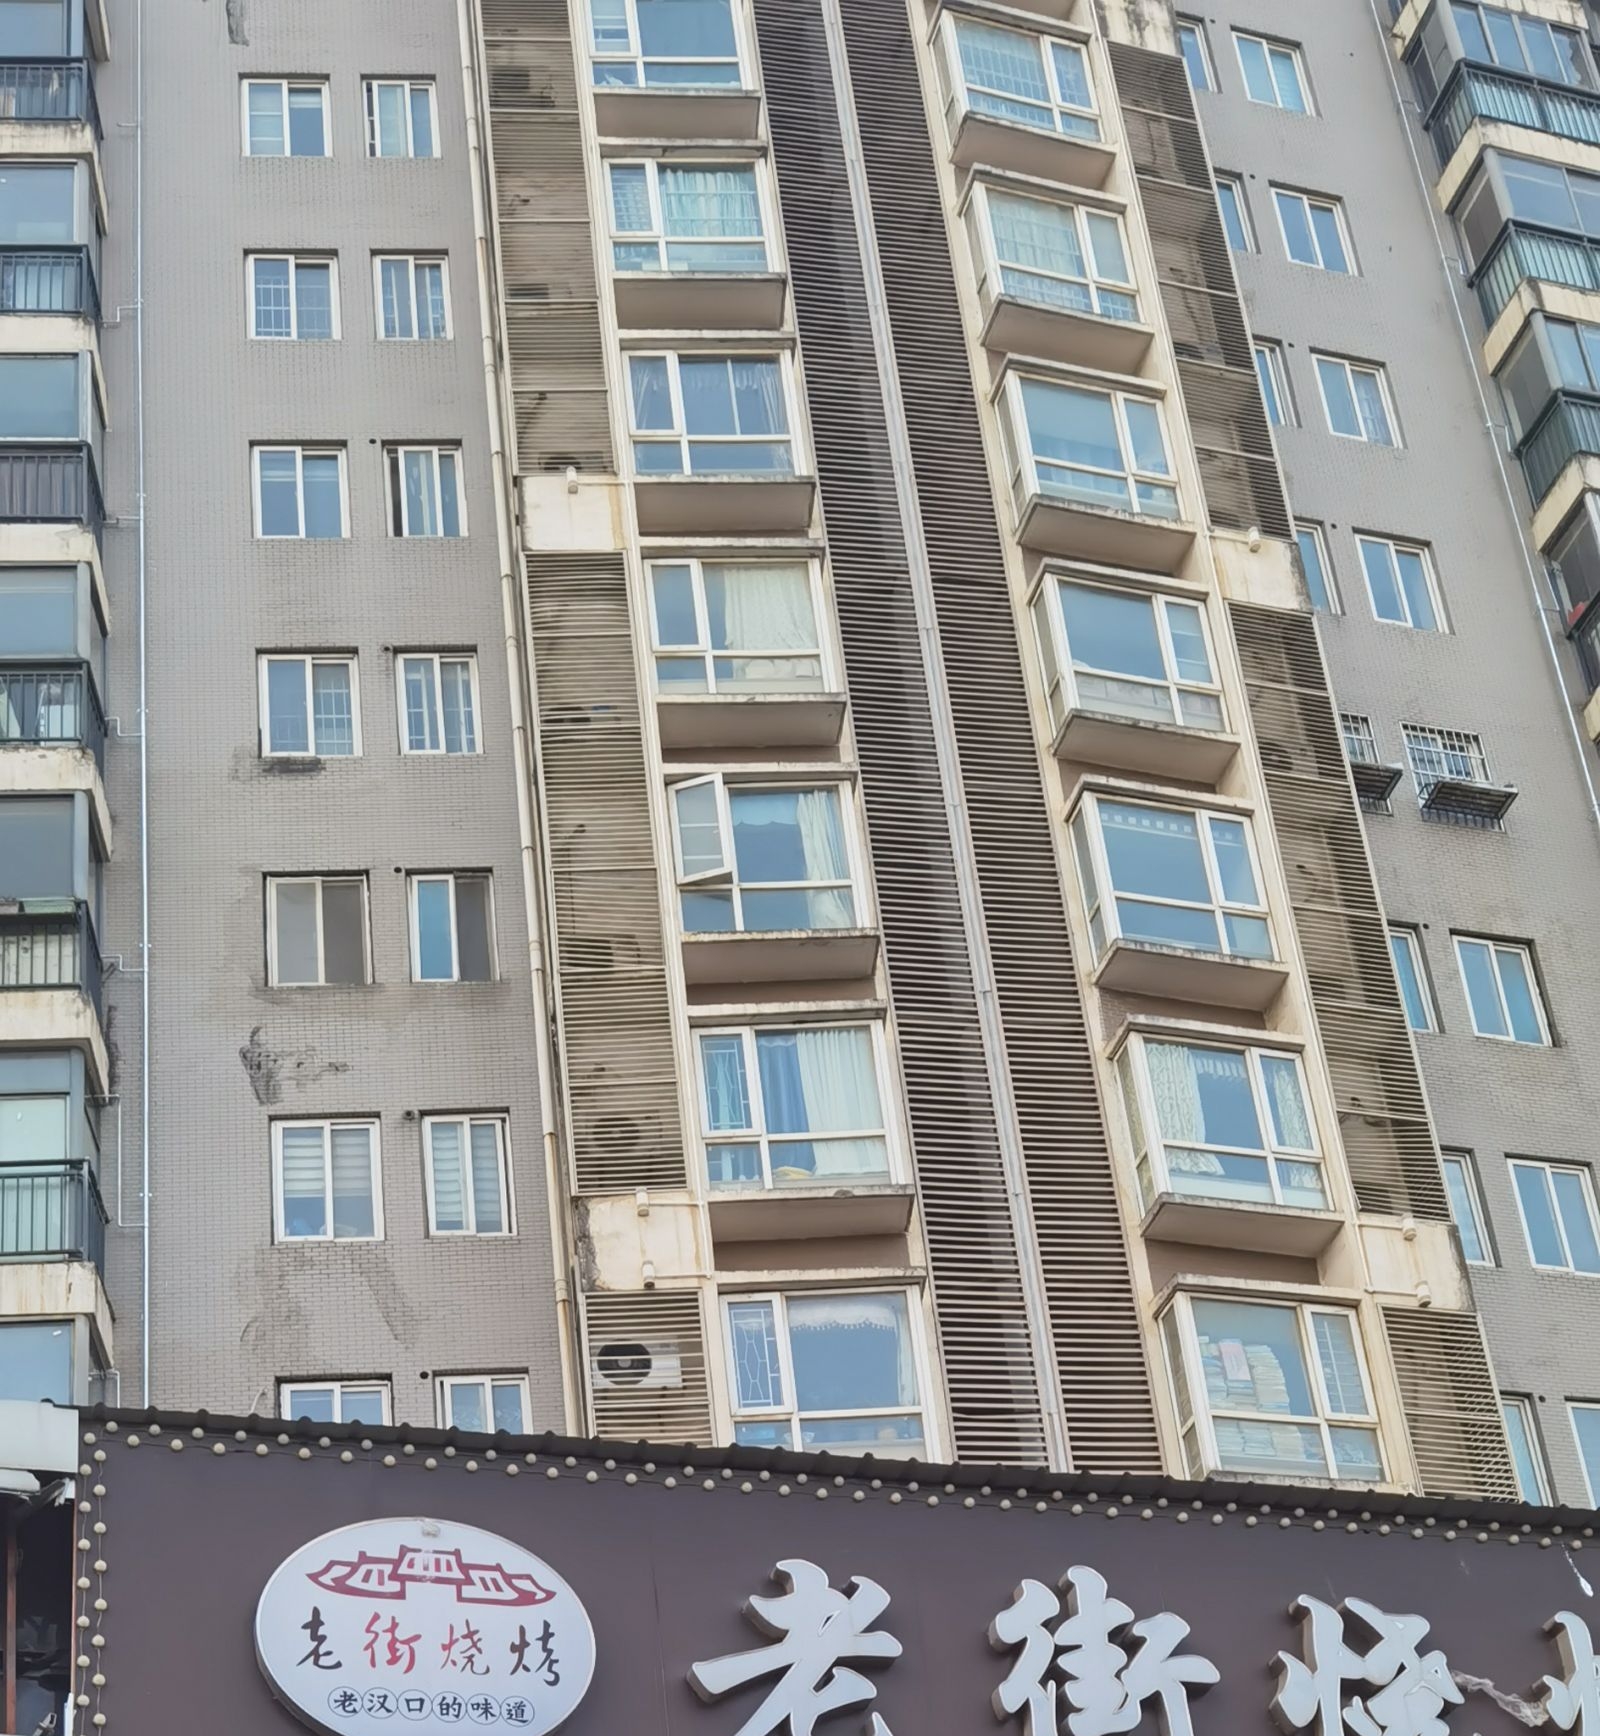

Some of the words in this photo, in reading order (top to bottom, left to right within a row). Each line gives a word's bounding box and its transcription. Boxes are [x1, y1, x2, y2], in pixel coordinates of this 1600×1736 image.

[296, 1605, 562, 1687] 老街烧烤
[331, 1690, 534, 1725] 老汉口的味道
